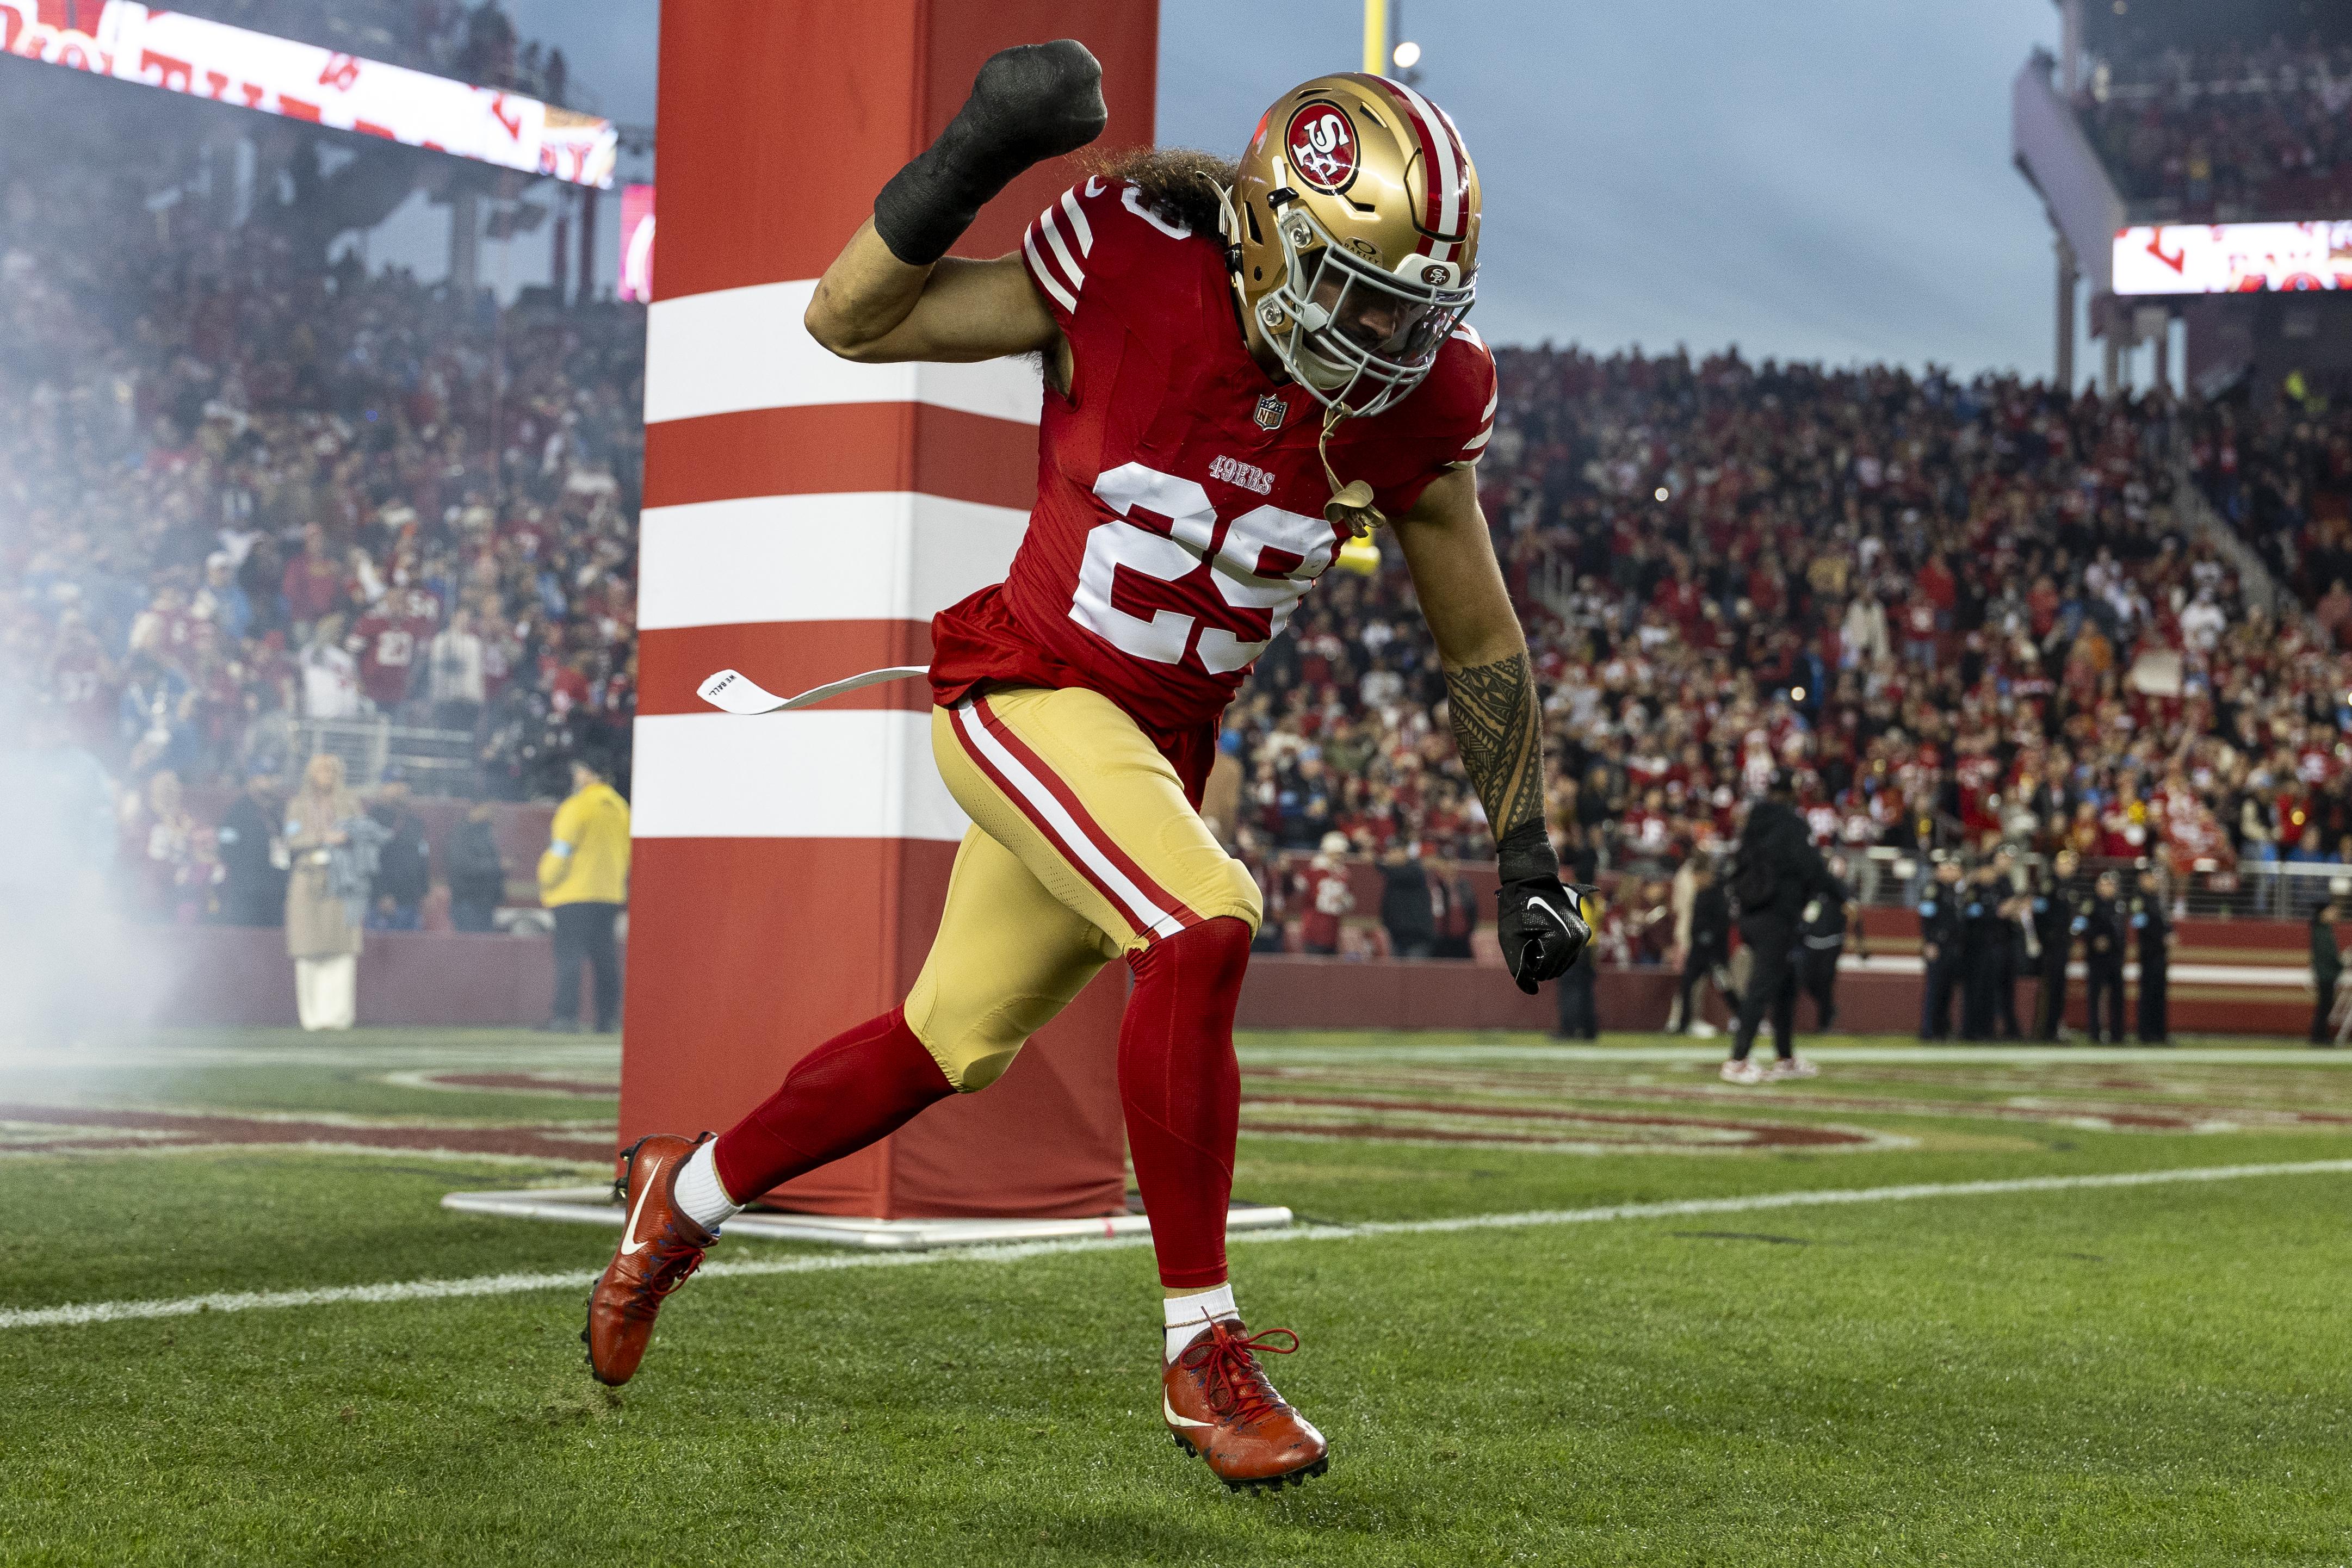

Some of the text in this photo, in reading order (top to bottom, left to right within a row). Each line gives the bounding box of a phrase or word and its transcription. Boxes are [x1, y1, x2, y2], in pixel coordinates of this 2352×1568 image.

[1292, 114, 1350, 177] SF
[1344, 243, 1379, 264] OAKLEY
[1430, 268, 1446, 284] SF
[1258, 408, 1278, 426] NFL
[1209, 455, 1275, 495] 49ERS
[1068, 461, 1336, 675] 29
[709, 674, 737, 695] WE BALL.
